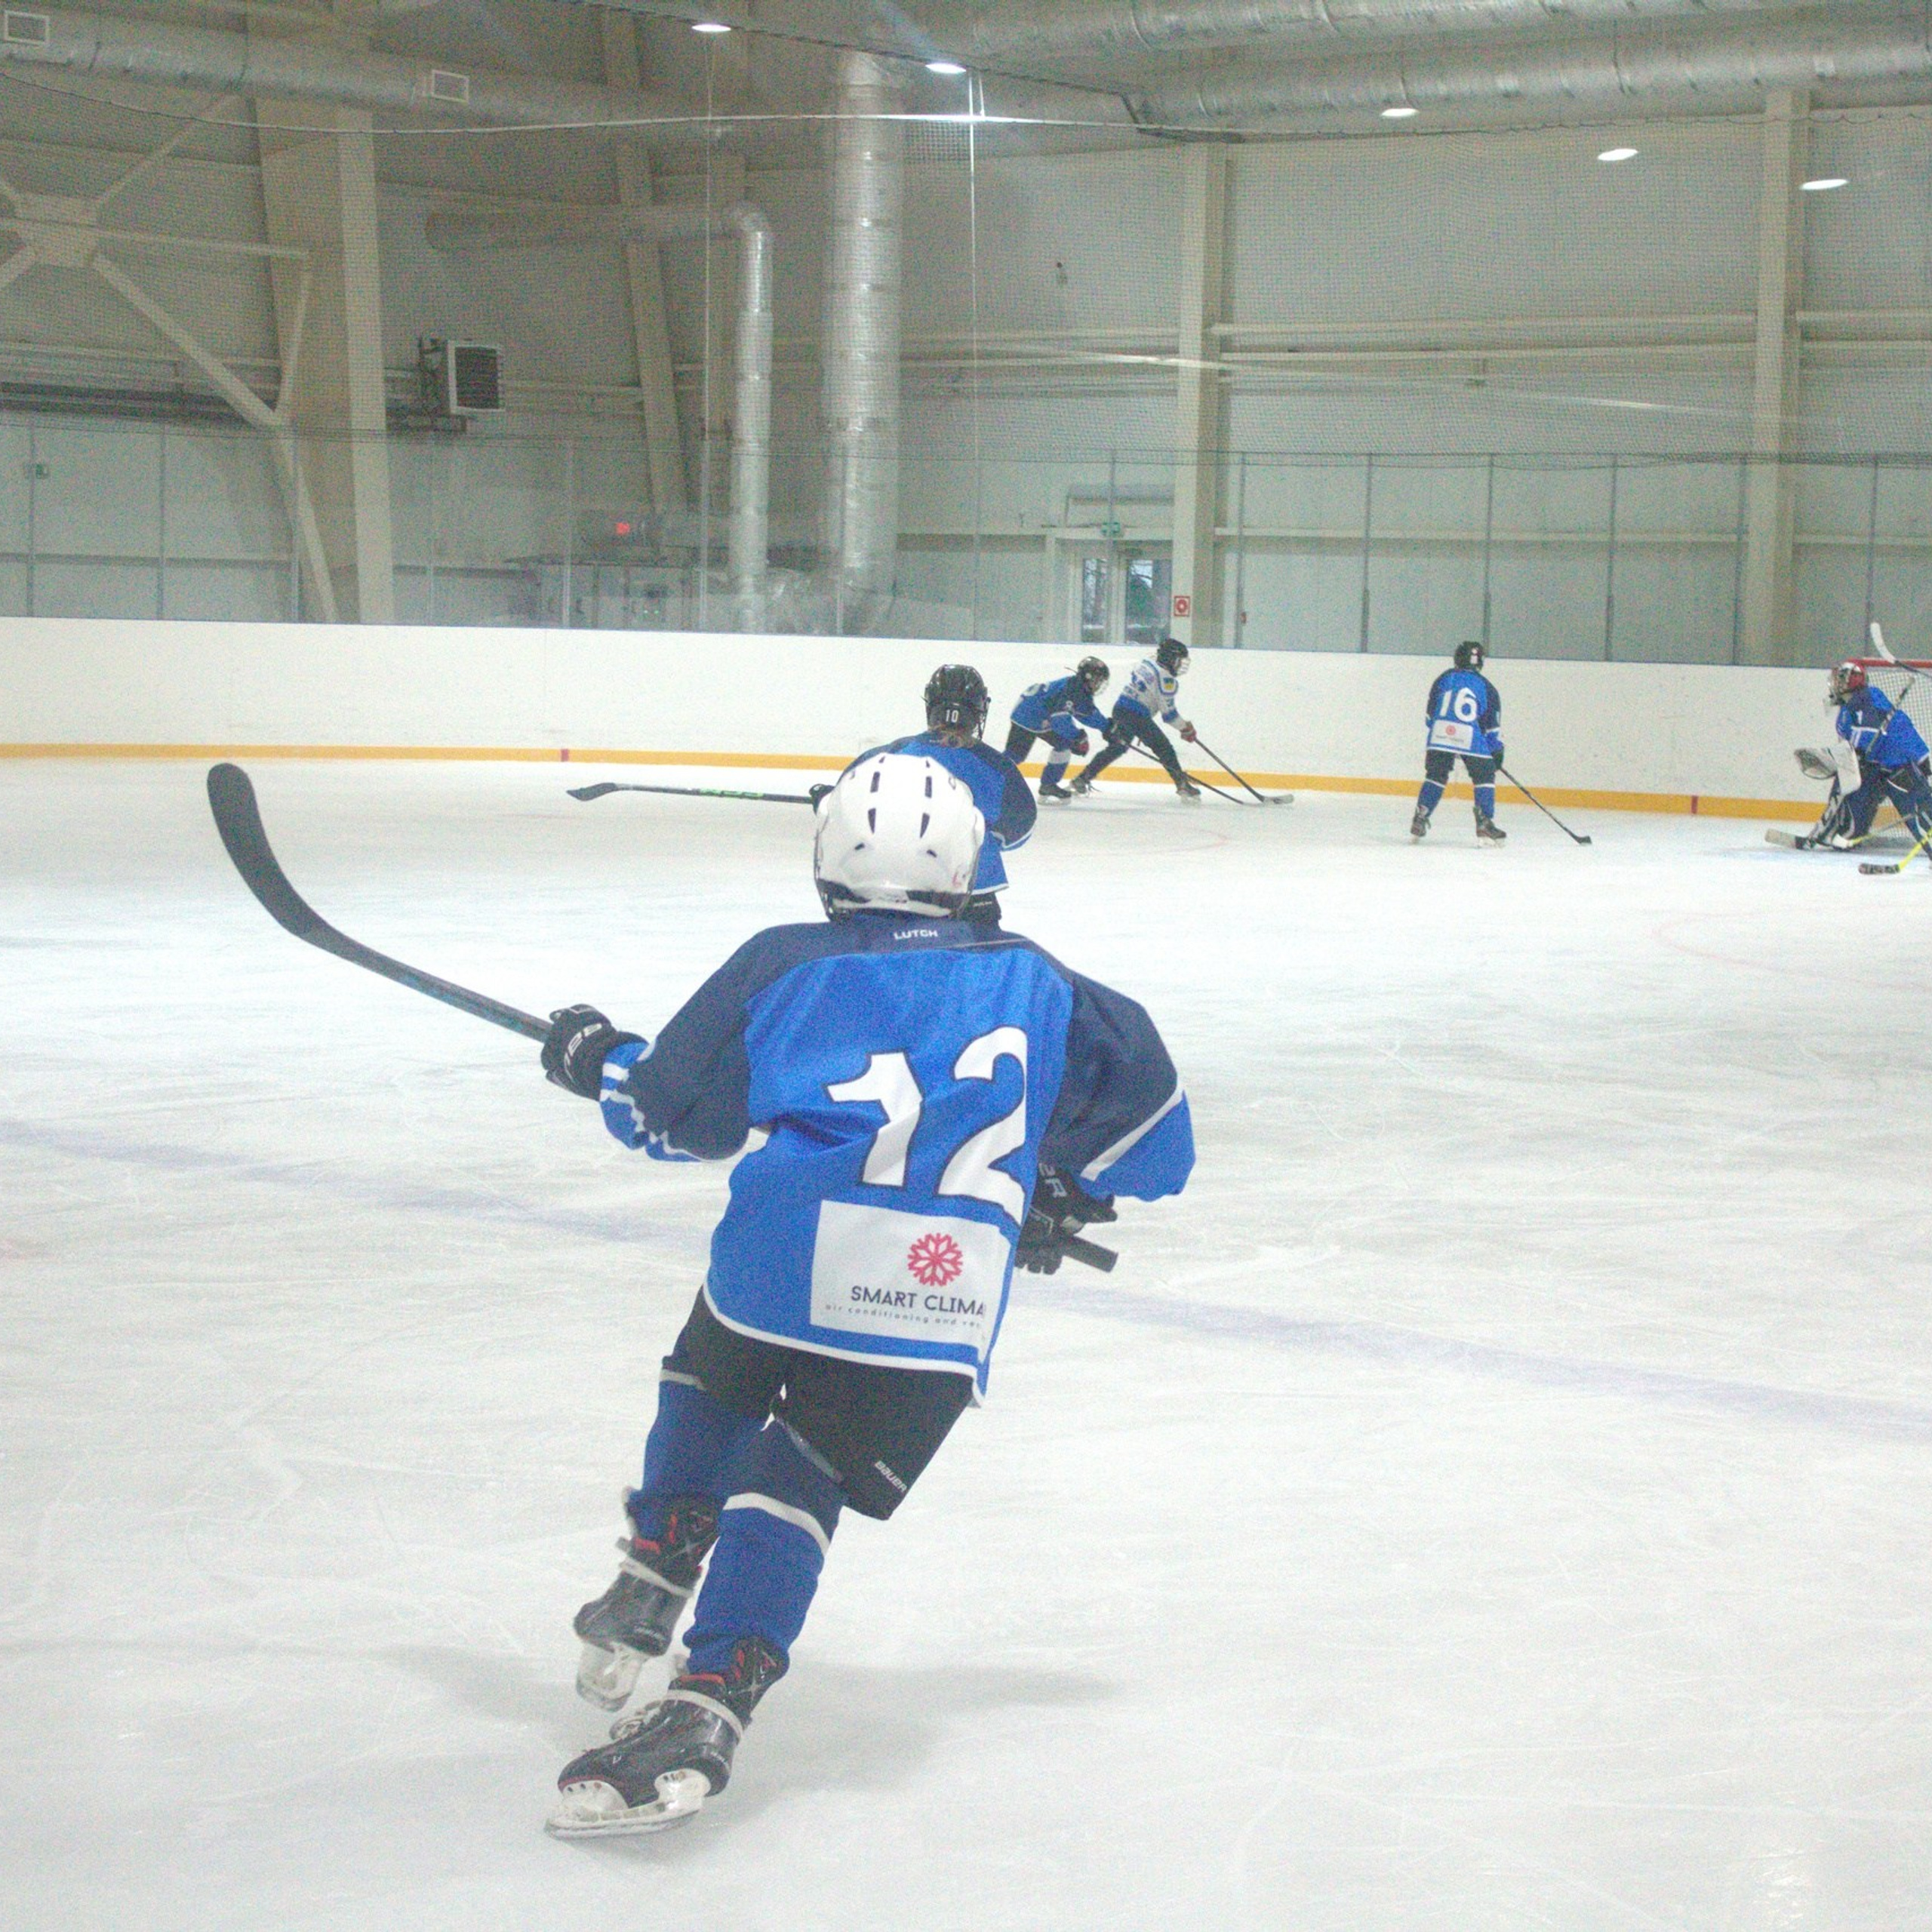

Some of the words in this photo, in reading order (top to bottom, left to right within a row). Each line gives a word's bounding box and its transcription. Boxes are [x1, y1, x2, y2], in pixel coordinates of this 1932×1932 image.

[1439, 685, 1477, 722] 16
[946, 709, 958, 722] 10
[894, 929, 938, 940] LUTCH
[827, 1027, 1027, 1226] 12
[851, 1285, 917, 1308] SMART
[825, 1303, 842, 1312] air
[848, 1307, 928, 1324] conditioning
[934, 1317, 956, 1325] and
